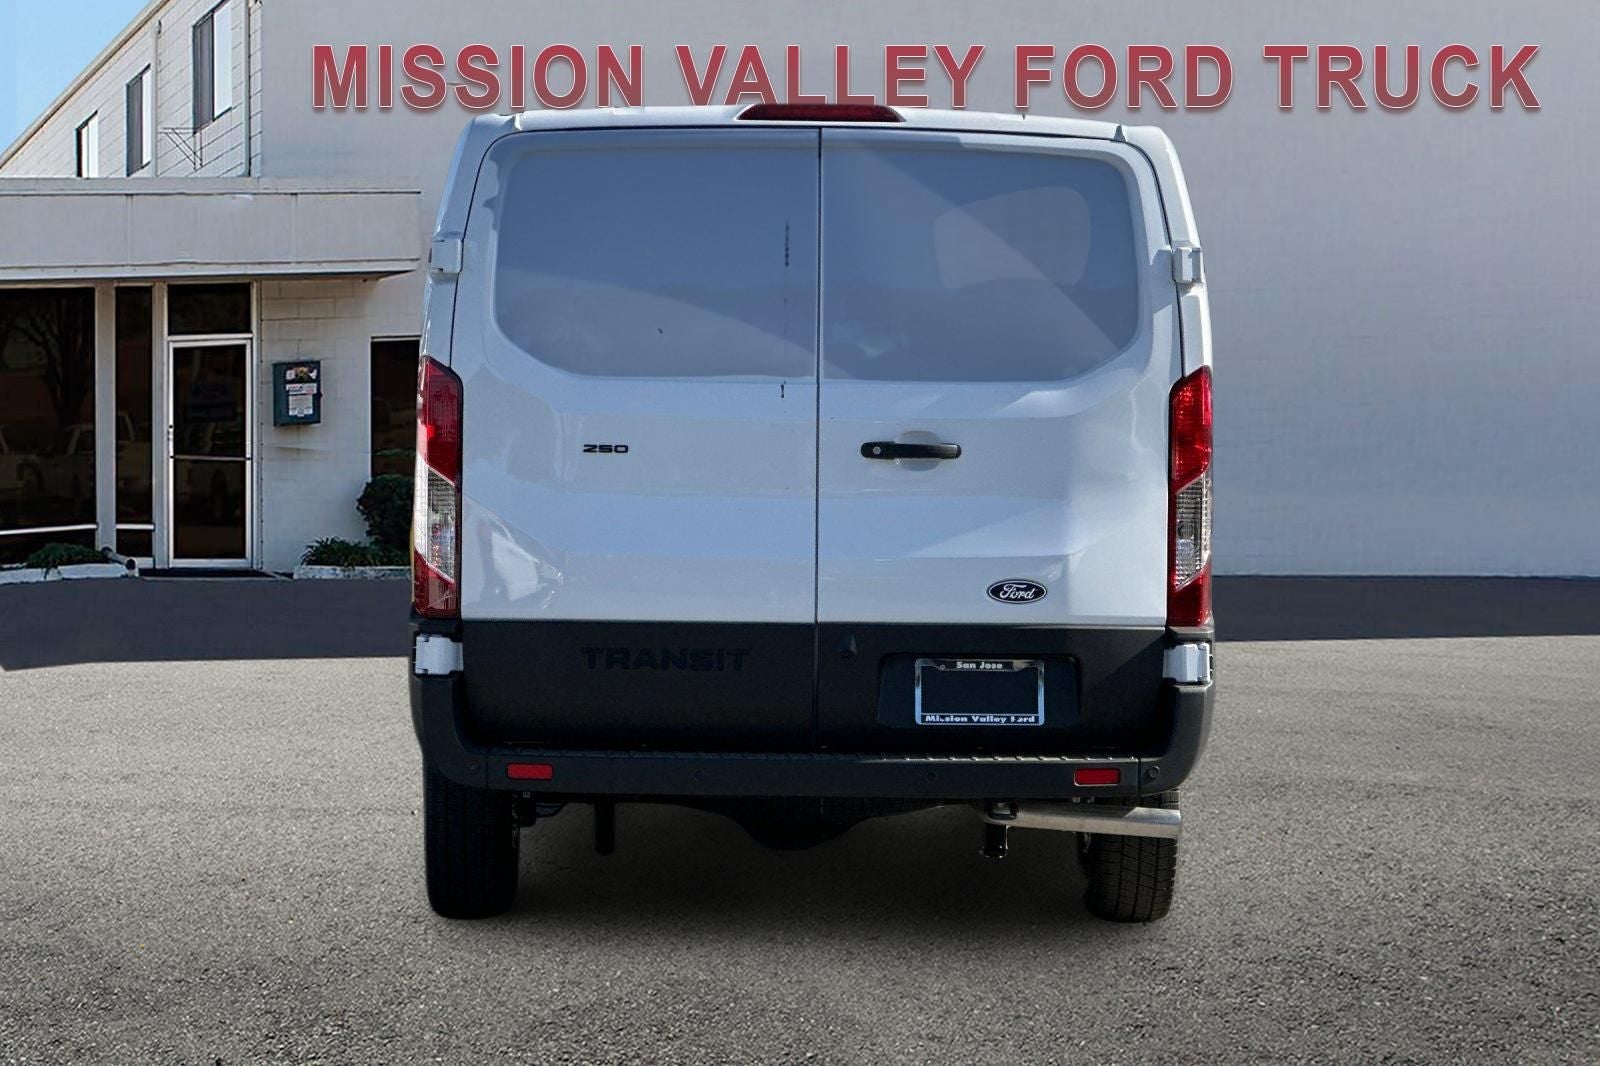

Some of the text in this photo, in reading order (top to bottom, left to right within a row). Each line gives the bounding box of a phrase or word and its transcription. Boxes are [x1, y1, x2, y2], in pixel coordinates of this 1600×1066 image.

[312, 44, 1541, 108] MISSION VALLEY FORD TRUCK
[583, 444, 629, 453] 250
[999, 583, 1036, 599] Ford
[580, 648, 751, 671] TRANSIT
[956, 661, 1003, 669] San Jose
[971, 715, 1007, 724] Valley
